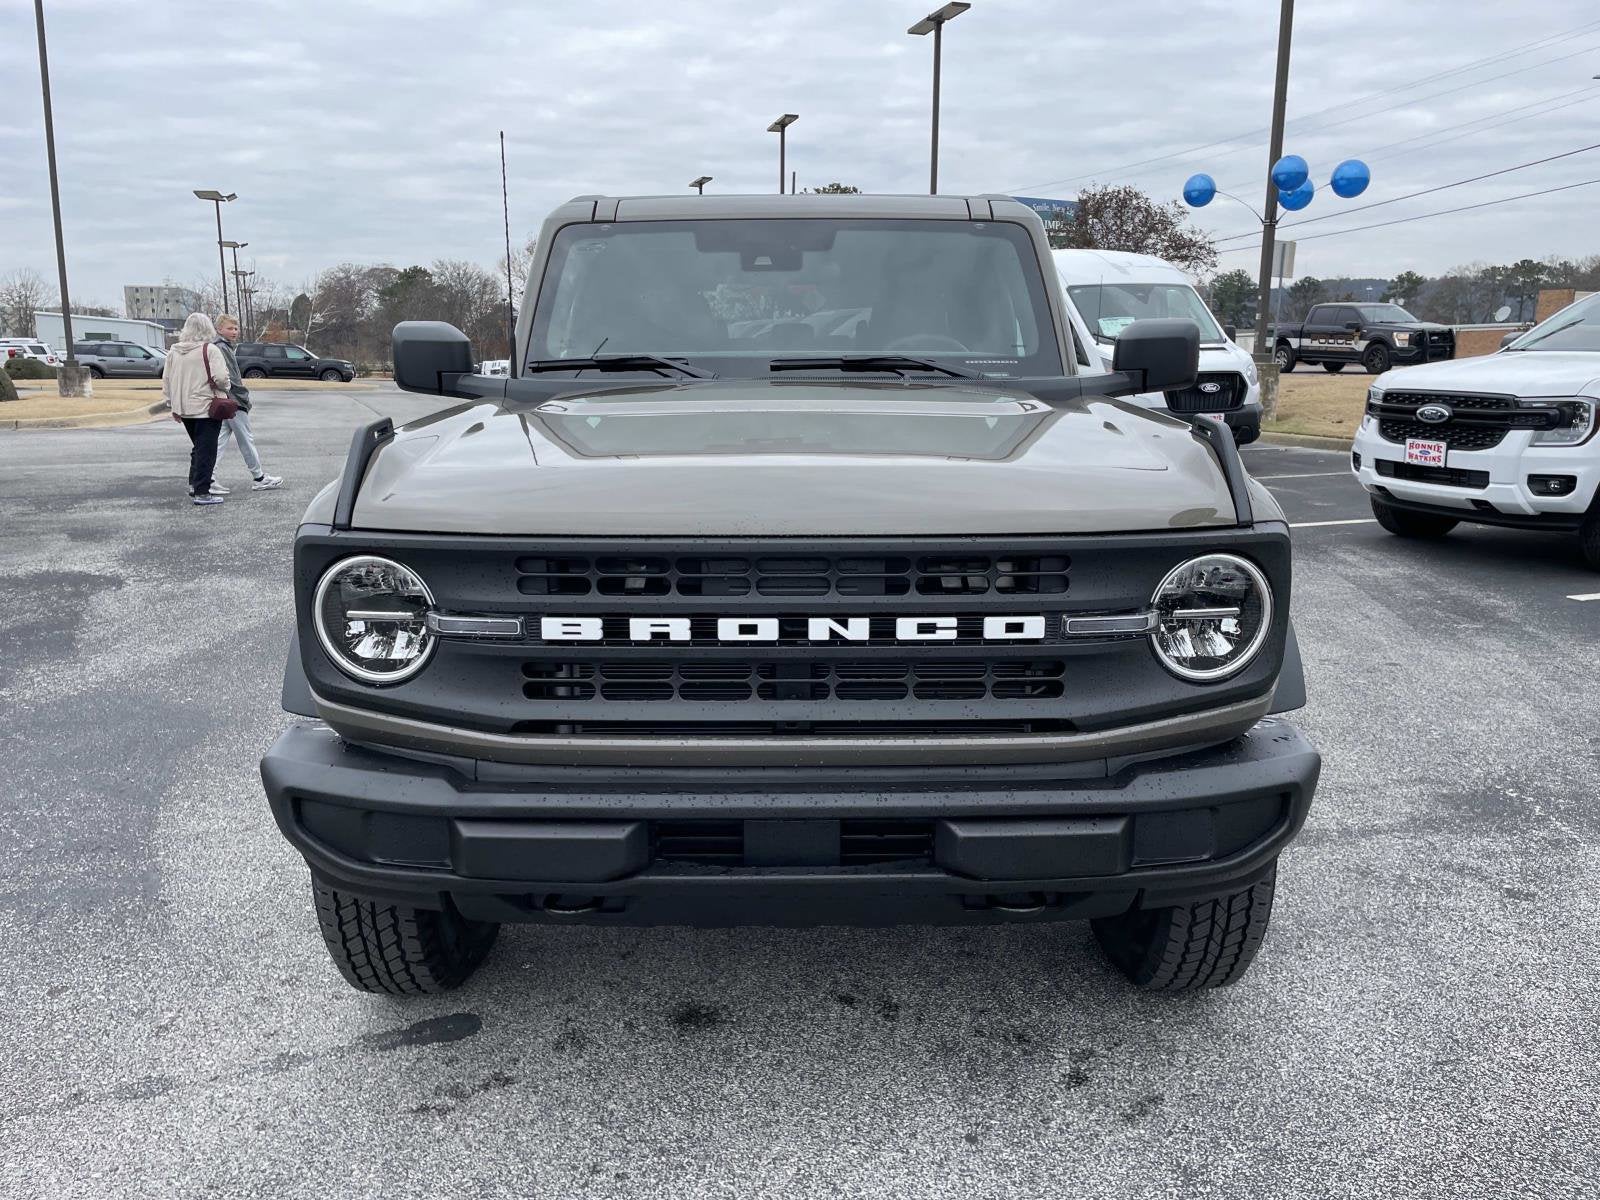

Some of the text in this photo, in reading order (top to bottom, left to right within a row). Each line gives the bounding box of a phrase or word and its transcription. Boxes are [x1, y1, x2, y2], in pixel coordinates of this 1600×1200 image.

[1310, 334, 1353, 346] POLICE
[1408, 441, 1443, 453] RONNIE
[1408, 452, 1442, 463] WATKINS
[541, 617, 1046, 642] BRONCO
